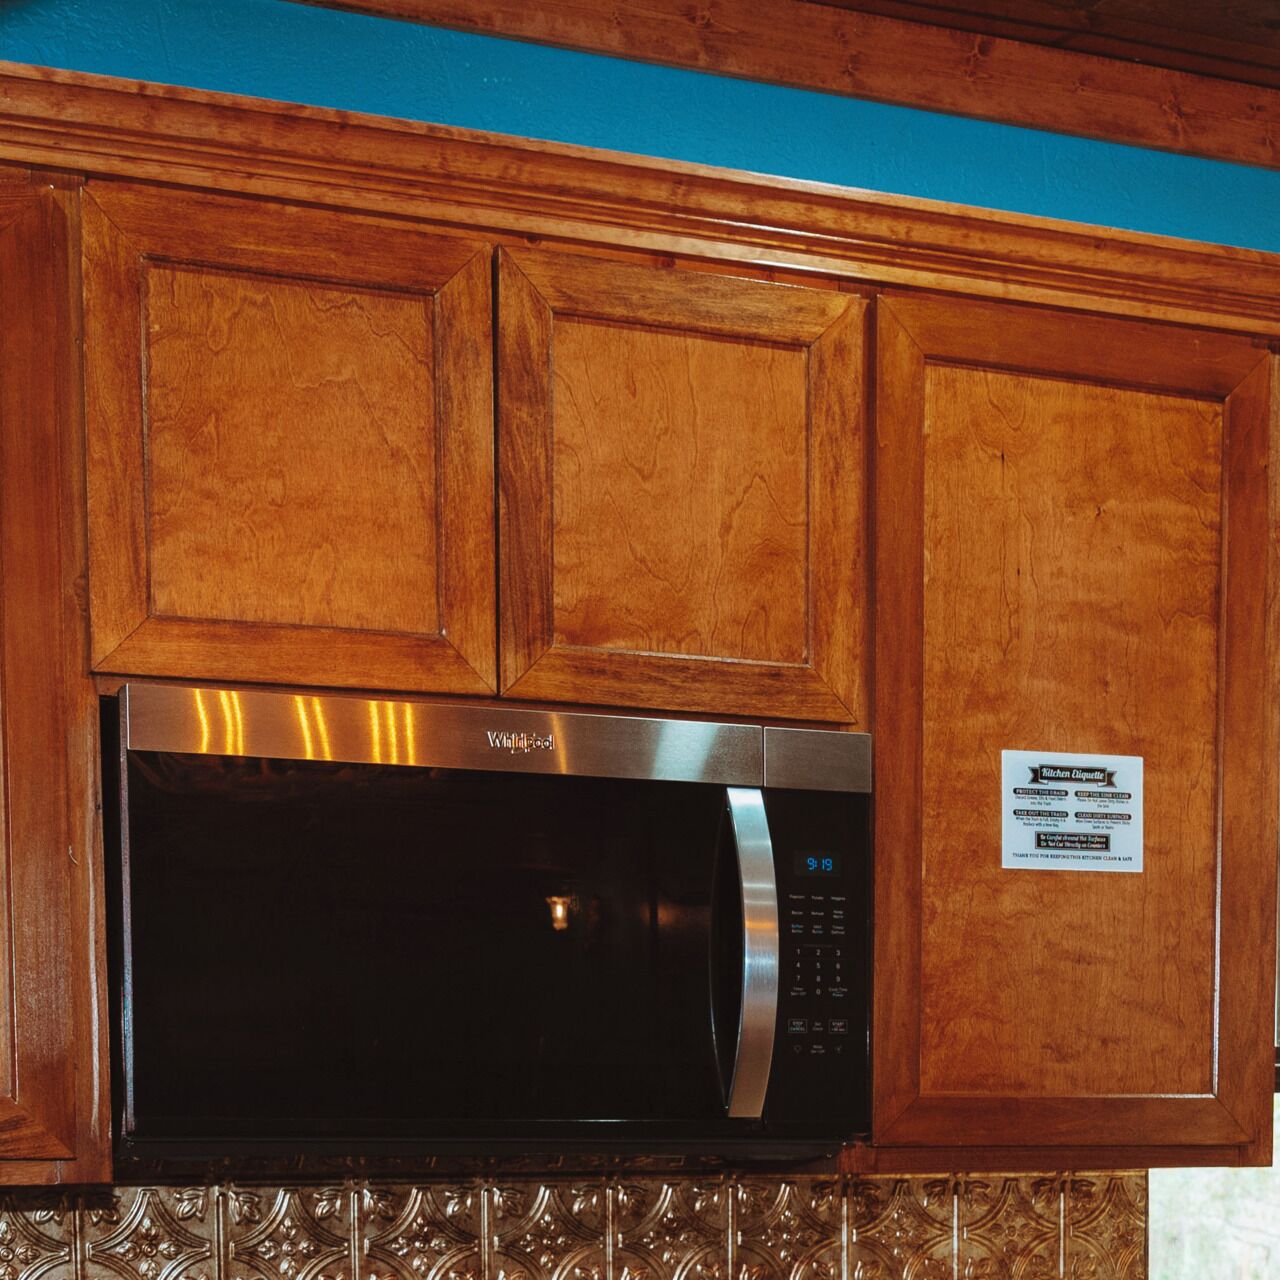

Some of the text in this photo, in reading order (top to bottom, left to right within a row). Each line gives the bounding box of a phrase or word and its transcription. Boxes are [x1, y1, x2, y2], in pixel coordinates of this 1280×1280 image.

[487, 731, 555, 754] Whirlpool
[1041, 767, 1104, 781] Kitchen Etiquette
[807, 857, 833, 871] 9:19
